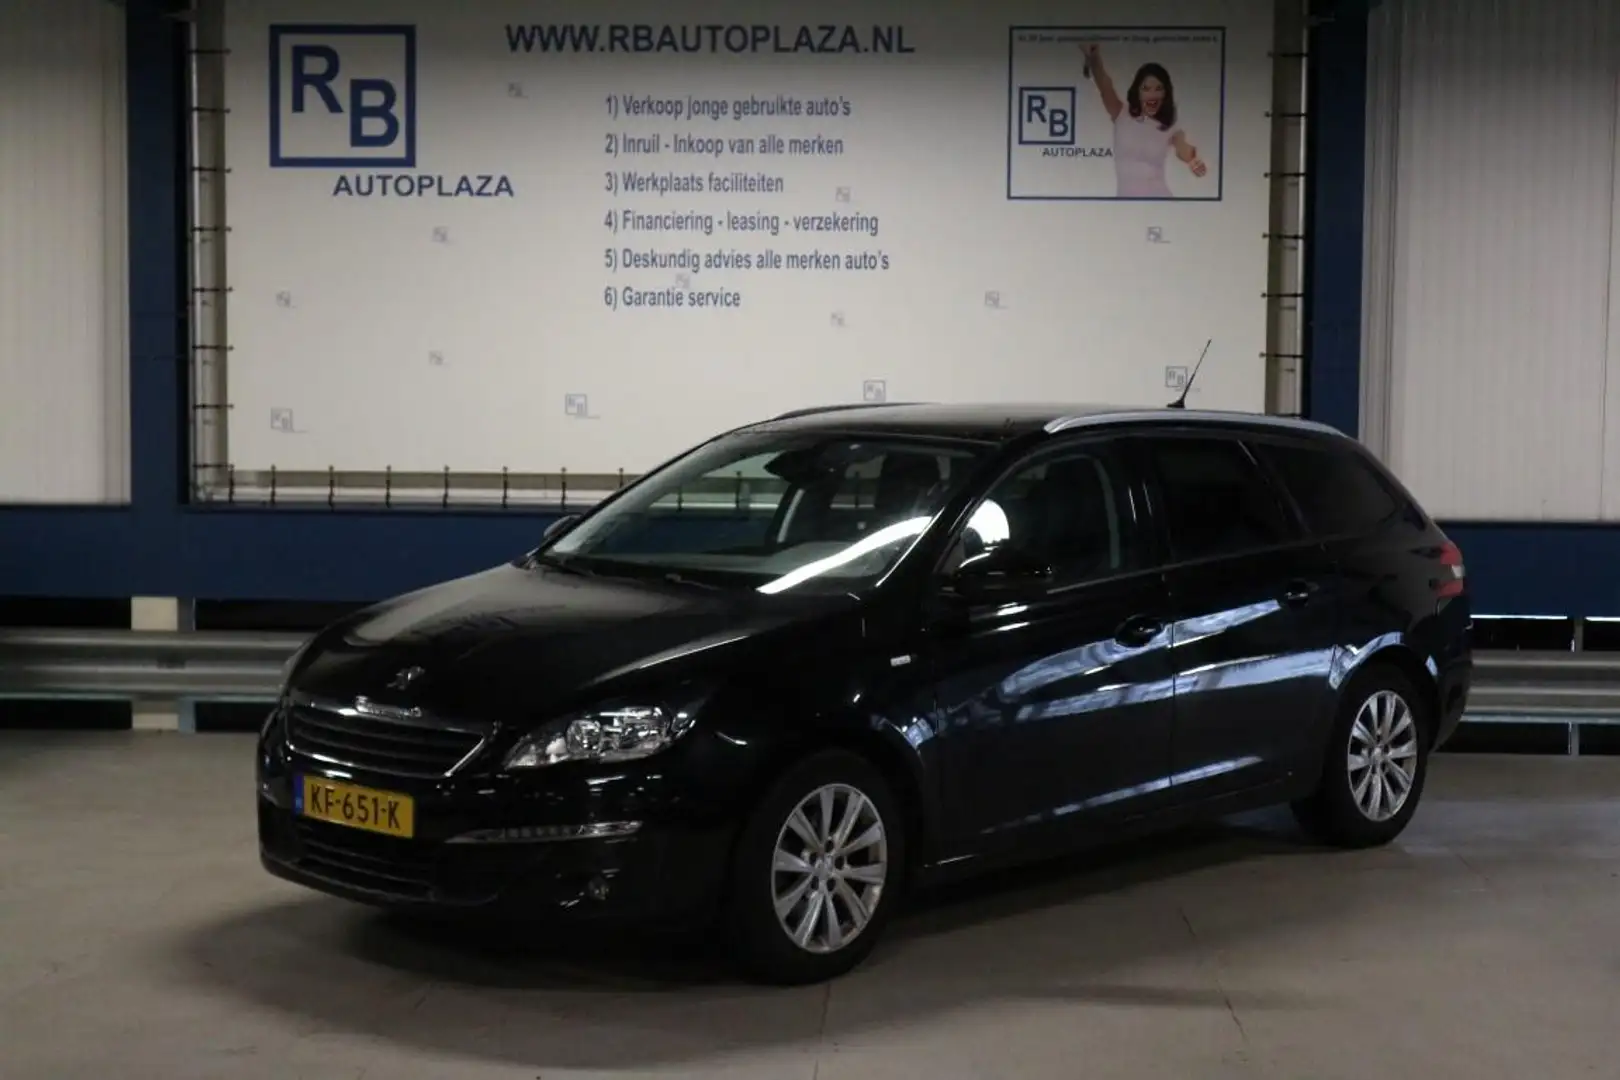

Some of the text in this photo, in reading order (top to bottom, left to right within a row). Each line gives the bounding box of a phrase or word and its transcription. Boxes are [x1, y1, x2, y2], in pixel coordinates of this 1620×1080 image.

[505, 25, 916, 54] WWW.RBAUTOPLAZA.NL
[605, 95, 851, 121] 1) Verkoop jonge gebruikte auto's
[605, 134, 618, 158] 2)
[622, 134, 660, 154] Inruil
[673, 134, 724, 158] Inkoop
[728, 139, 754, 154] van
[759, 135, 784, 154] alle
[788, 134, 843, 155] merken
[1042, 147, 1114, 158] AUTOPLAZA
[332, 174, 514, 198] AUTOPLAZA
[605, 172, 784, 196] 3) Werkplaats faciliteiten
[604, 210, 618, 233] 4)
[622, 210, 713, 235] Financiering
[727, 211, 780, 236] leasing
[793, 212, 879, 236] verzekering
[604, 248, 890, 274] 5) Deskundig advies alle merken auto's
[604, 286, 741, 310] 6) Garantie service
[311, 784, 400, 830] KF-651-K
